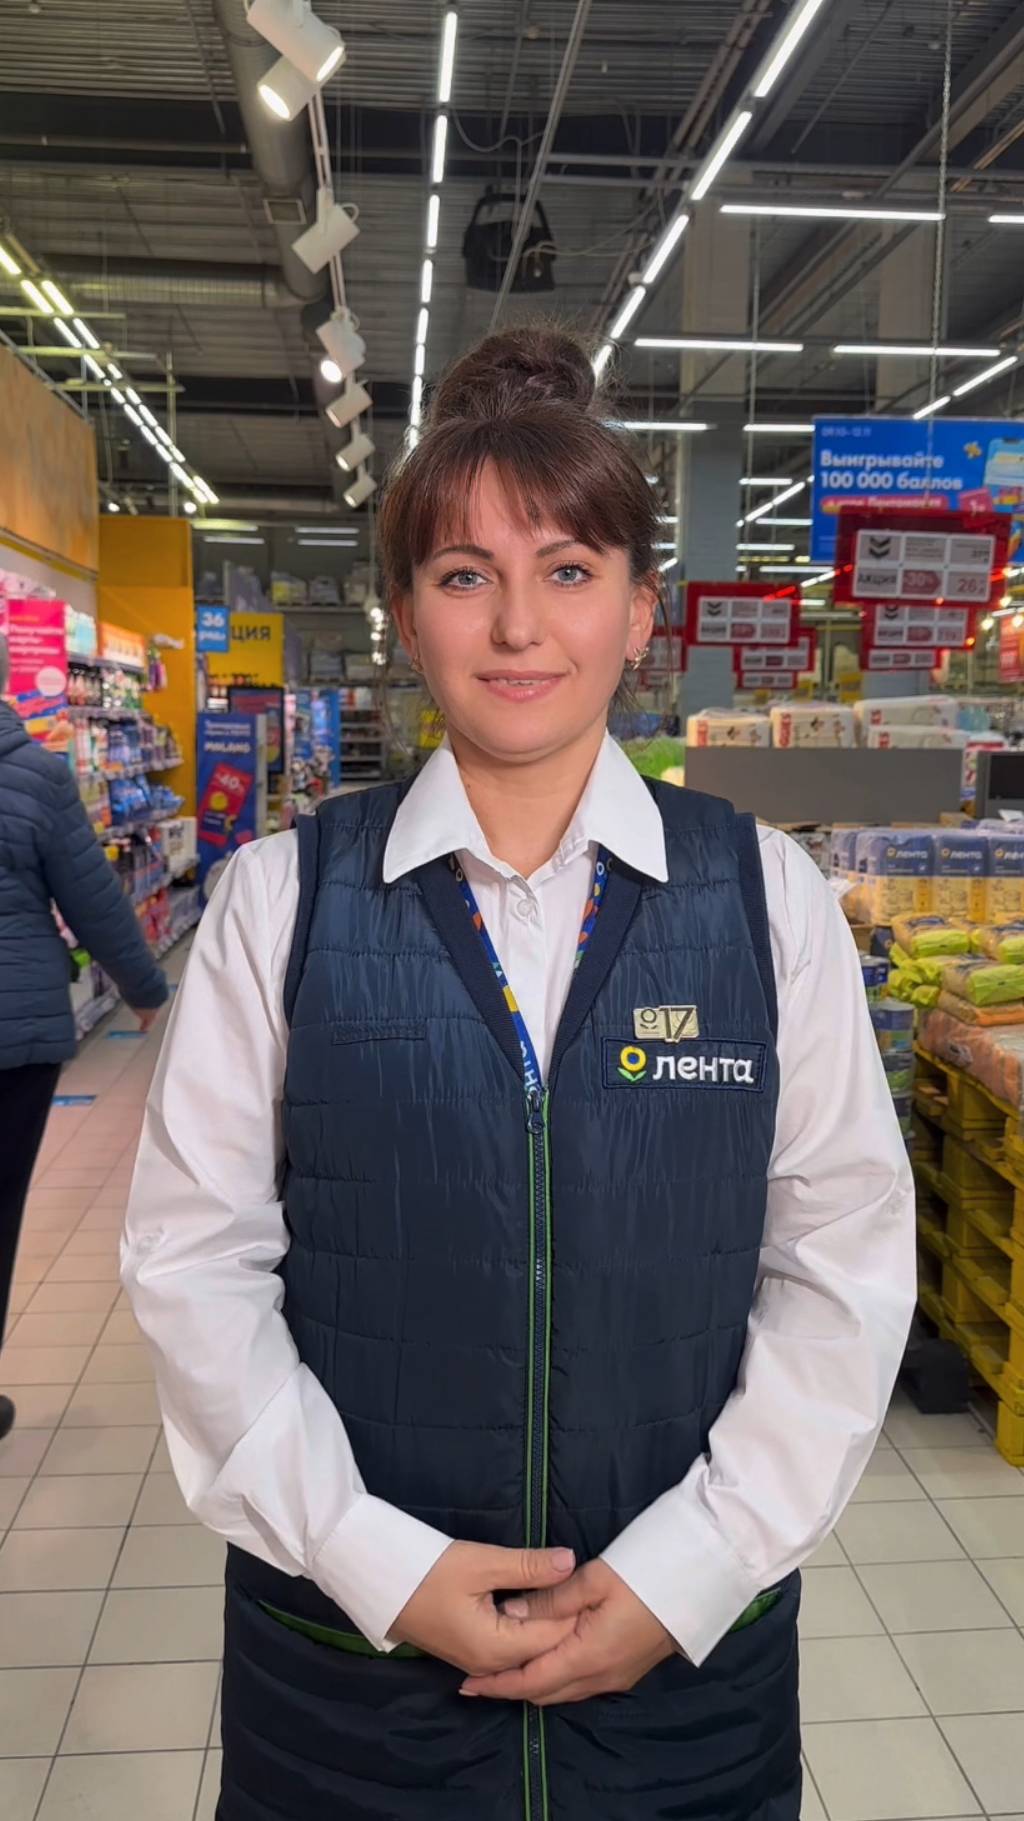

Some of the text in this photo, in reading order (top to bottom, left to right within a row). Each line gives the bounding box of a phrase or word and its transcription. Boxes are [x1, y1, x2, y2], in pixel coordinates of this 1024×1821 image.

[821, 449, 944, 472] Выигрывайте
[821, 471, 962, 489] 100 000 баллов
[202, 612, 225, 627] 36
[231, 626, 271, 642] ЦИЯ
[659, 1007, 694, 1040] 17
[653, 1056, 754, 1083] лента
